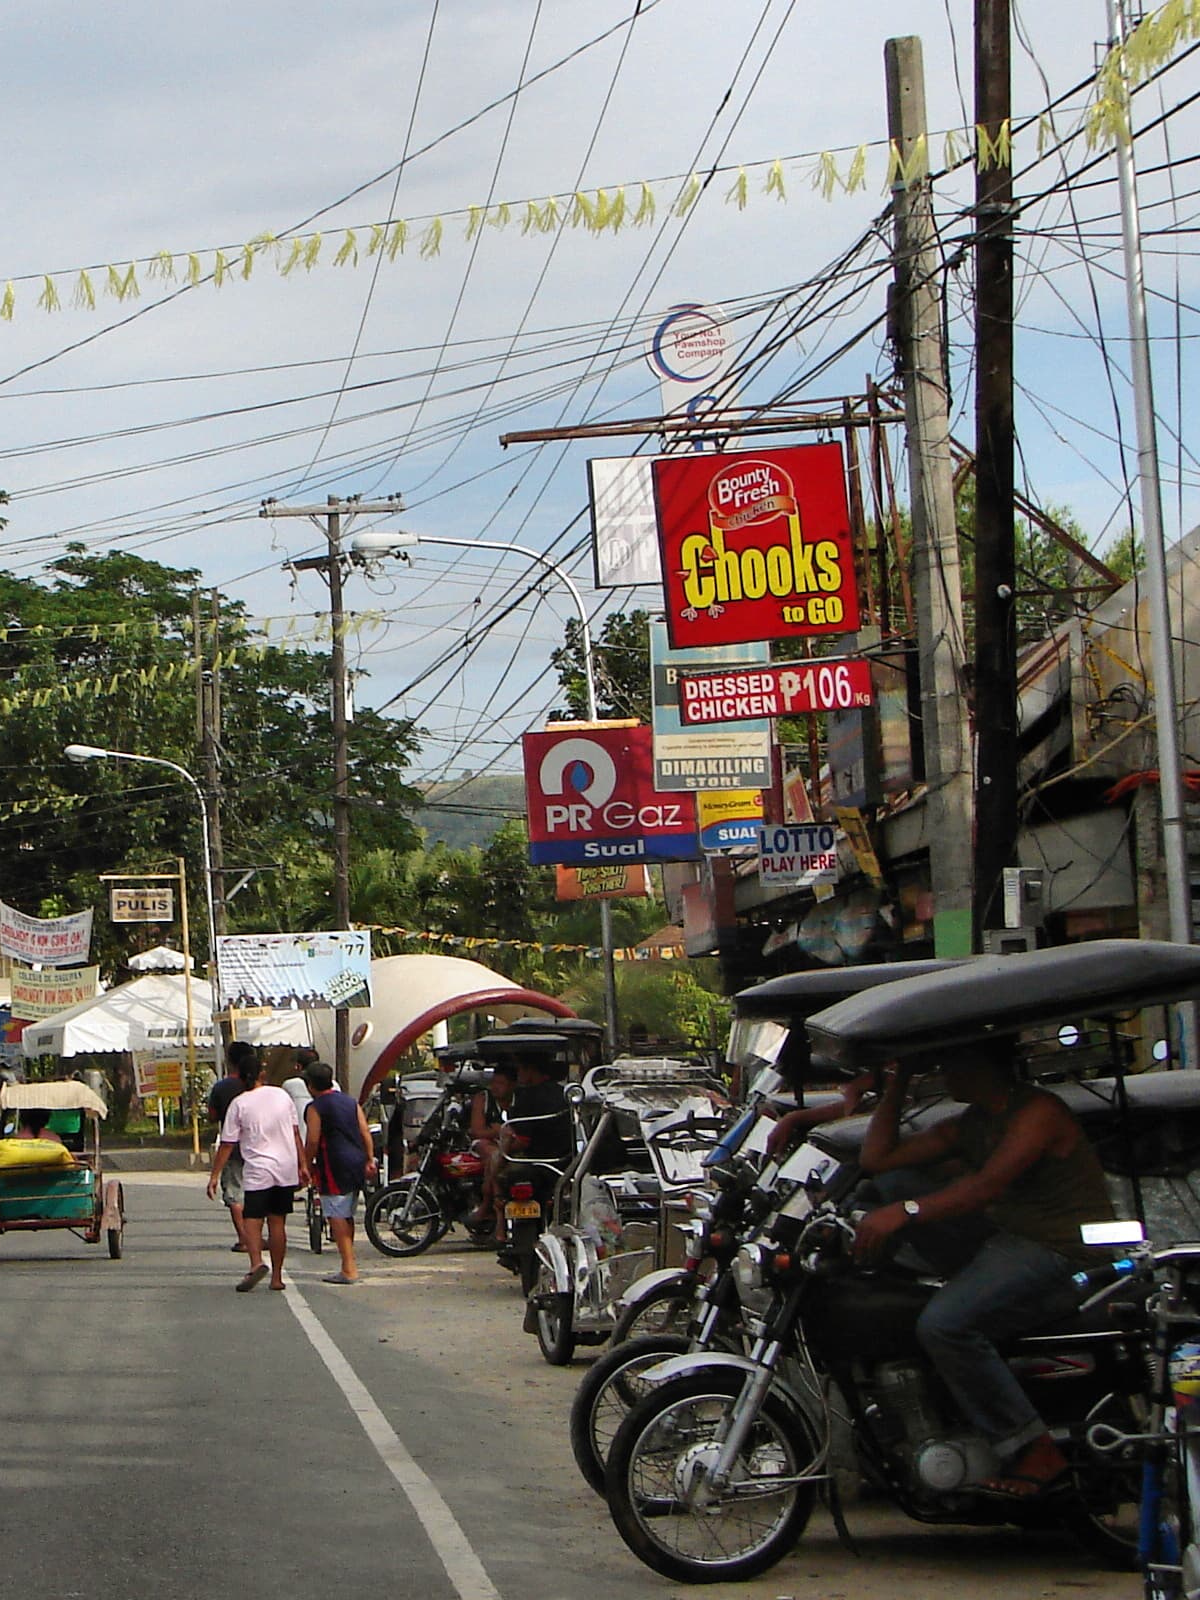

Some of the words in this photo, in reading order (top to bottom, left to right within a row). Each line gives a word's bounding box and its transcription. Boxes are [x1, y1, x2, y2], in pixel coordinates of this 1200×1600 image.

[674, 338, 726, 349] Pawnshop
[677, 349, 723, 359] Company
[717, 466, 771, 505] Bounty
[682, 515, 842, 609] Chooks
[782, 605, 804, 623] to
[807, 596, 843, 625] GO
[685, 673, 775, 700] DRESSED
[687, 694, 777, 721] CHICKEN
[661, 758, 765, 776] DIMAKILING
[686, 776, 741, 787] STORE
[546, 804, 592, 833] PR
[603, 801, 683, 829] Gaz
[718, 826, 758, 841] SUAL
[760, 826, 834, 854] LOTTO
[584, 839, 645, 857] Sual
[762, 855, 795, 873] PLAY
[800, 852, 837, 871] HERE
[117, 900, 168, 911] PULIS
[339, 943, 365, 956] '77
